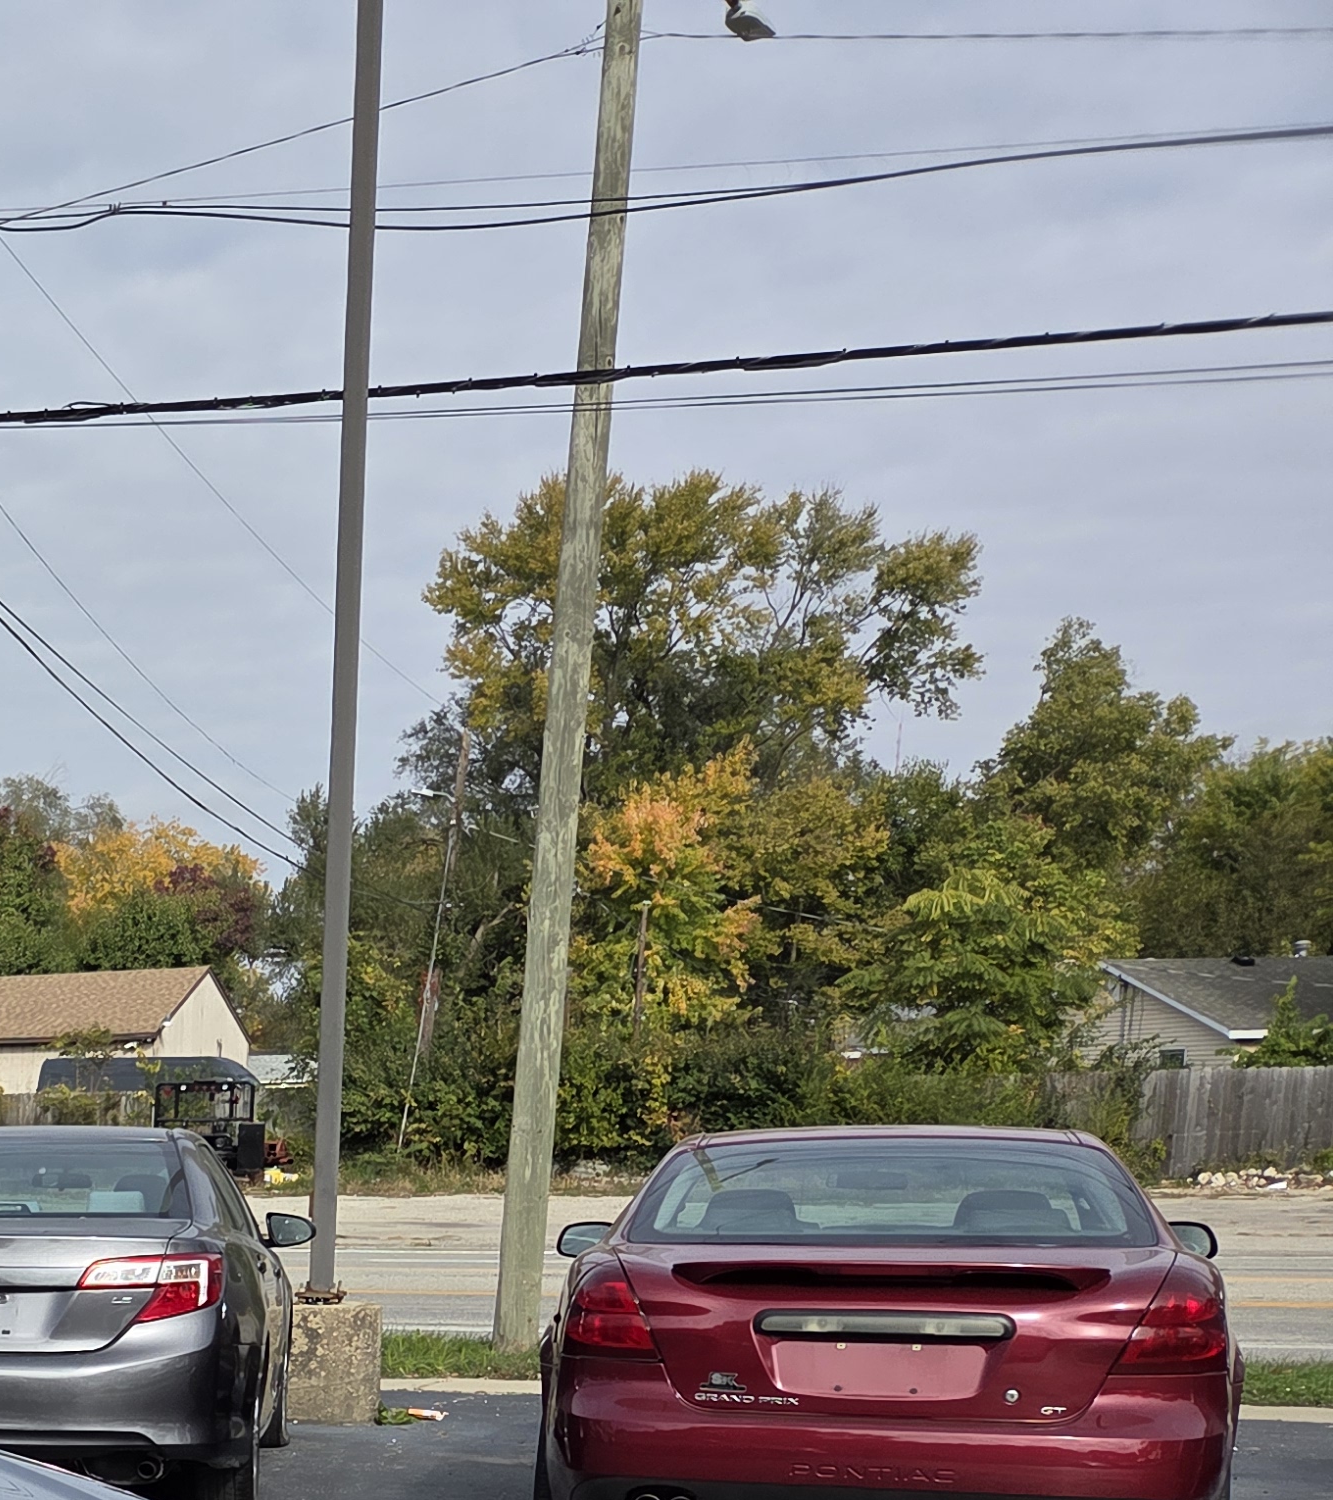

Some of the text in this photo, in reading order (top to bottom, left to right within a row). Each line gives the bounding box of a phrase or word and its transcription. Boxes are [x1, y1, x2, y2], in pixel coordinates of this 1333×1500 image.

[694, 1392, 800, 1406] GRAND PRIX
[1041, 1406, 1068, 1416] GT
[788, 1464, 956, 1484] PONTIAC
